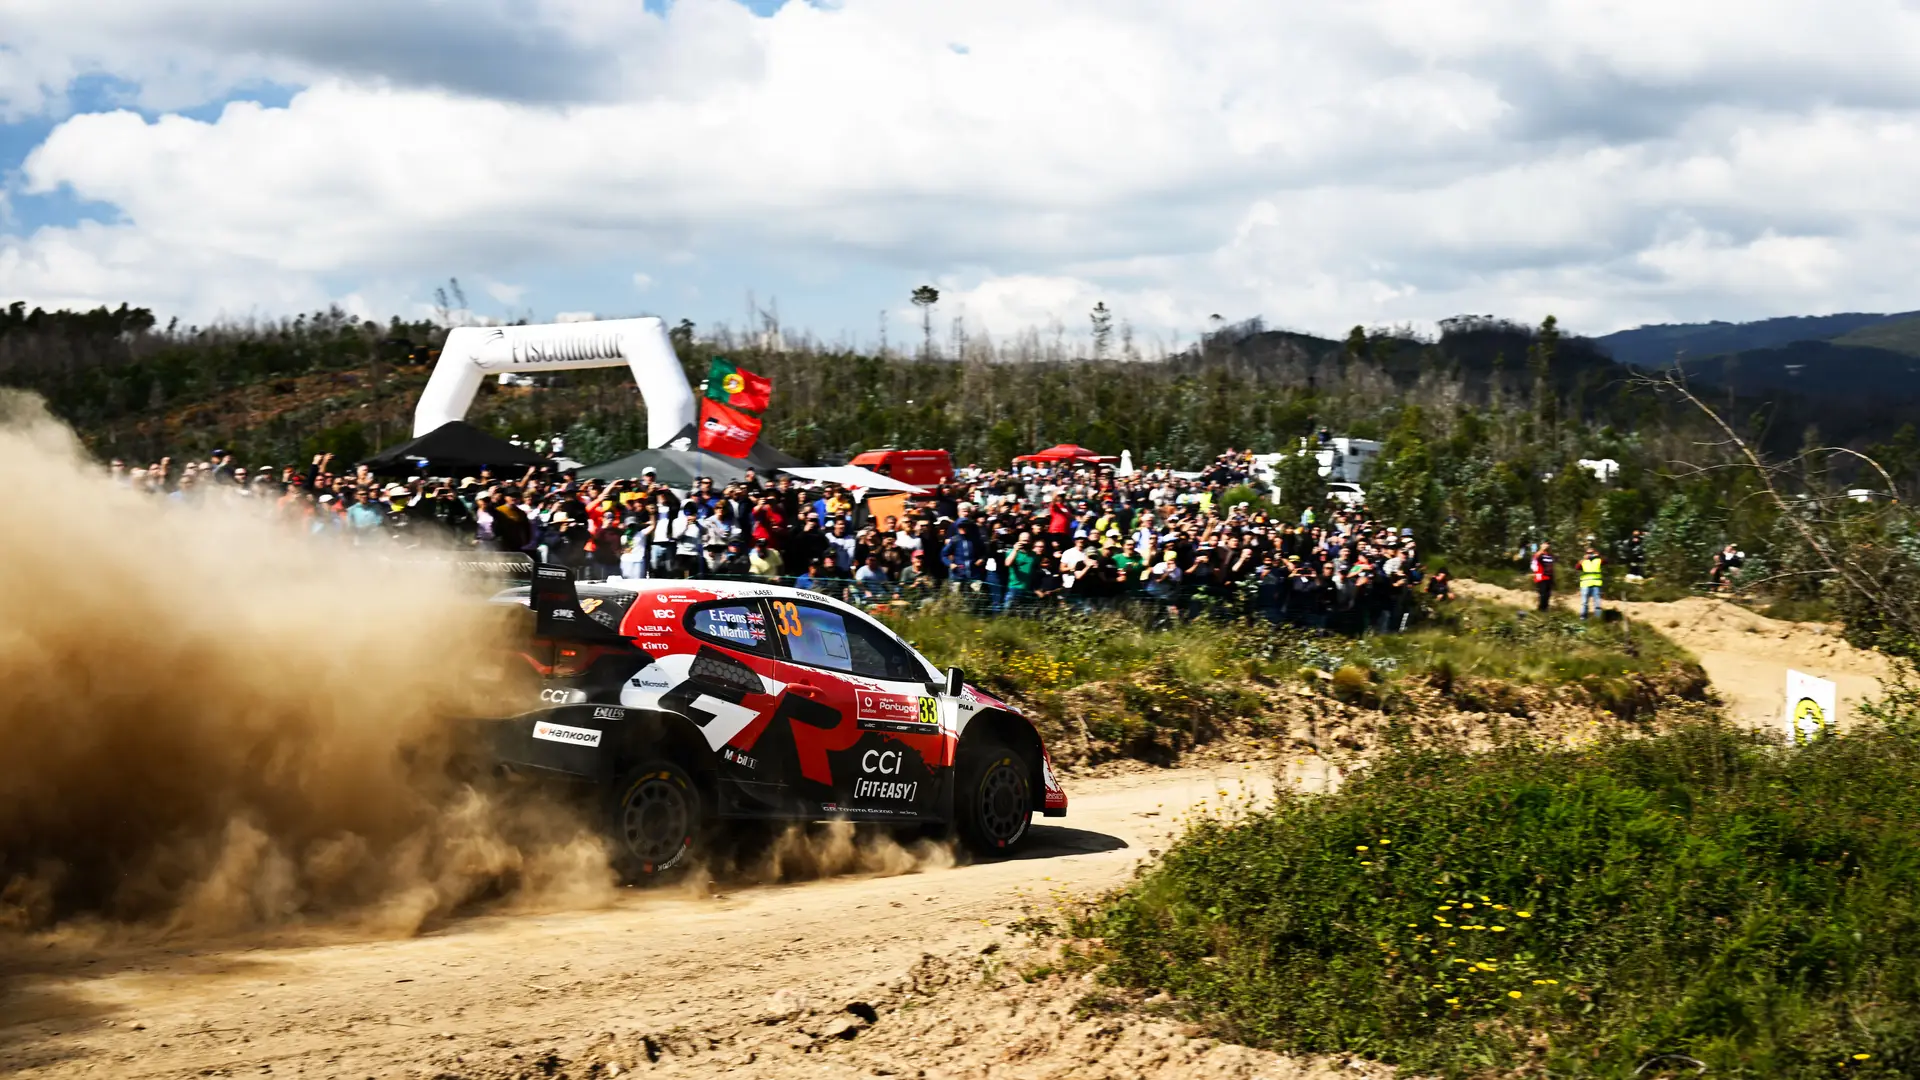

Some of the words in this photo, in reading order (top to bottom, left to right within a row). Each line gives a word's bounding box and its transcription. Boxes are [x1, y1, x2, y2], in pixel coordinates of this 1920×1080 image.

[796, 591, 830, 603] PROTERIAL
[709, 609, 747, 624] E.Evans
[773, 601, 803, 637] 33
[709, 624, 750, 639] S.Martin
[641, 680, 670, 689] Microsoft
[879, 702, 917, 714] Portugal
[919, 697, 939, 724] 33
